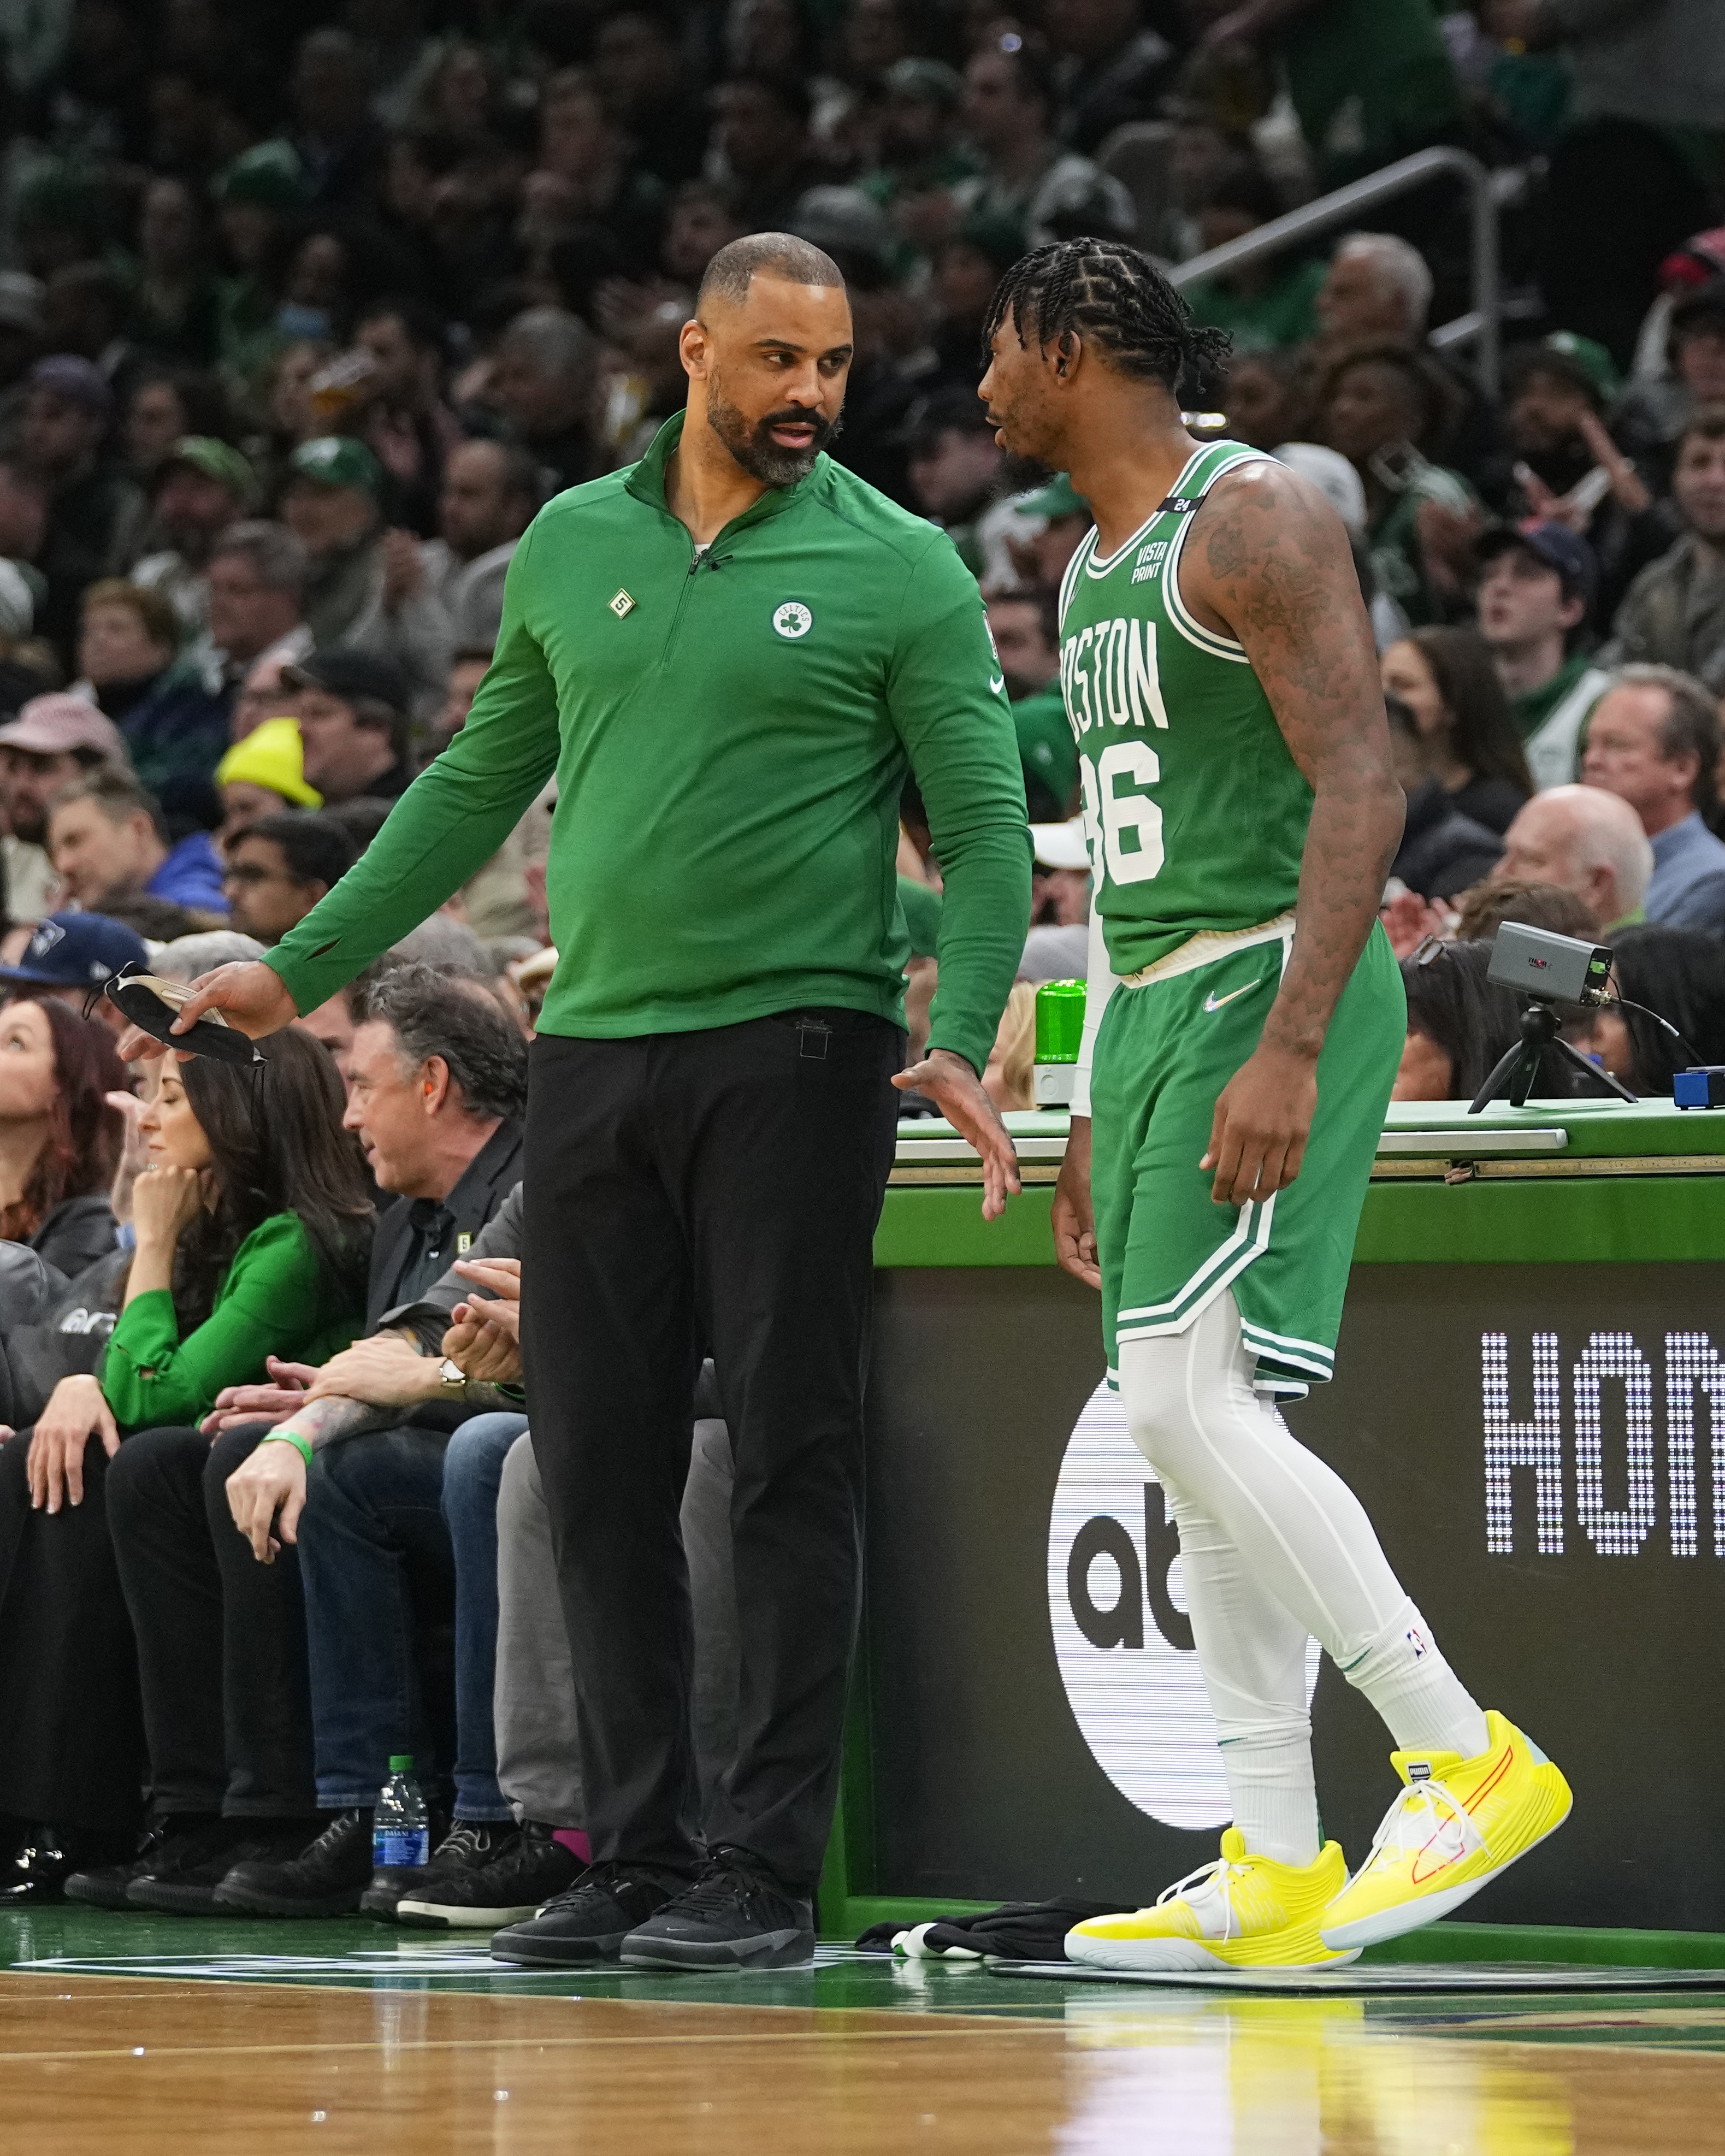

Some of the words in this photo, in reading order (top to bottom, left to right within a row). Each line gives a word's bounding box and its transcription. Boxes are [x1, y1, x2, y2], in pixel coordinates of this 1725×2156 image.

[1174, 499, 1191, 511] 24
[1136, 541, 1168, 567] VISTA
[1131, 562, 1162, 584] PRINT
[615, 596, 628, 610] 5
[778, 605, 810, 622] CELTICS
[1059, 618, 1169, 745] OSTON
[1409, 1767, 1429, 1776] PUMA
